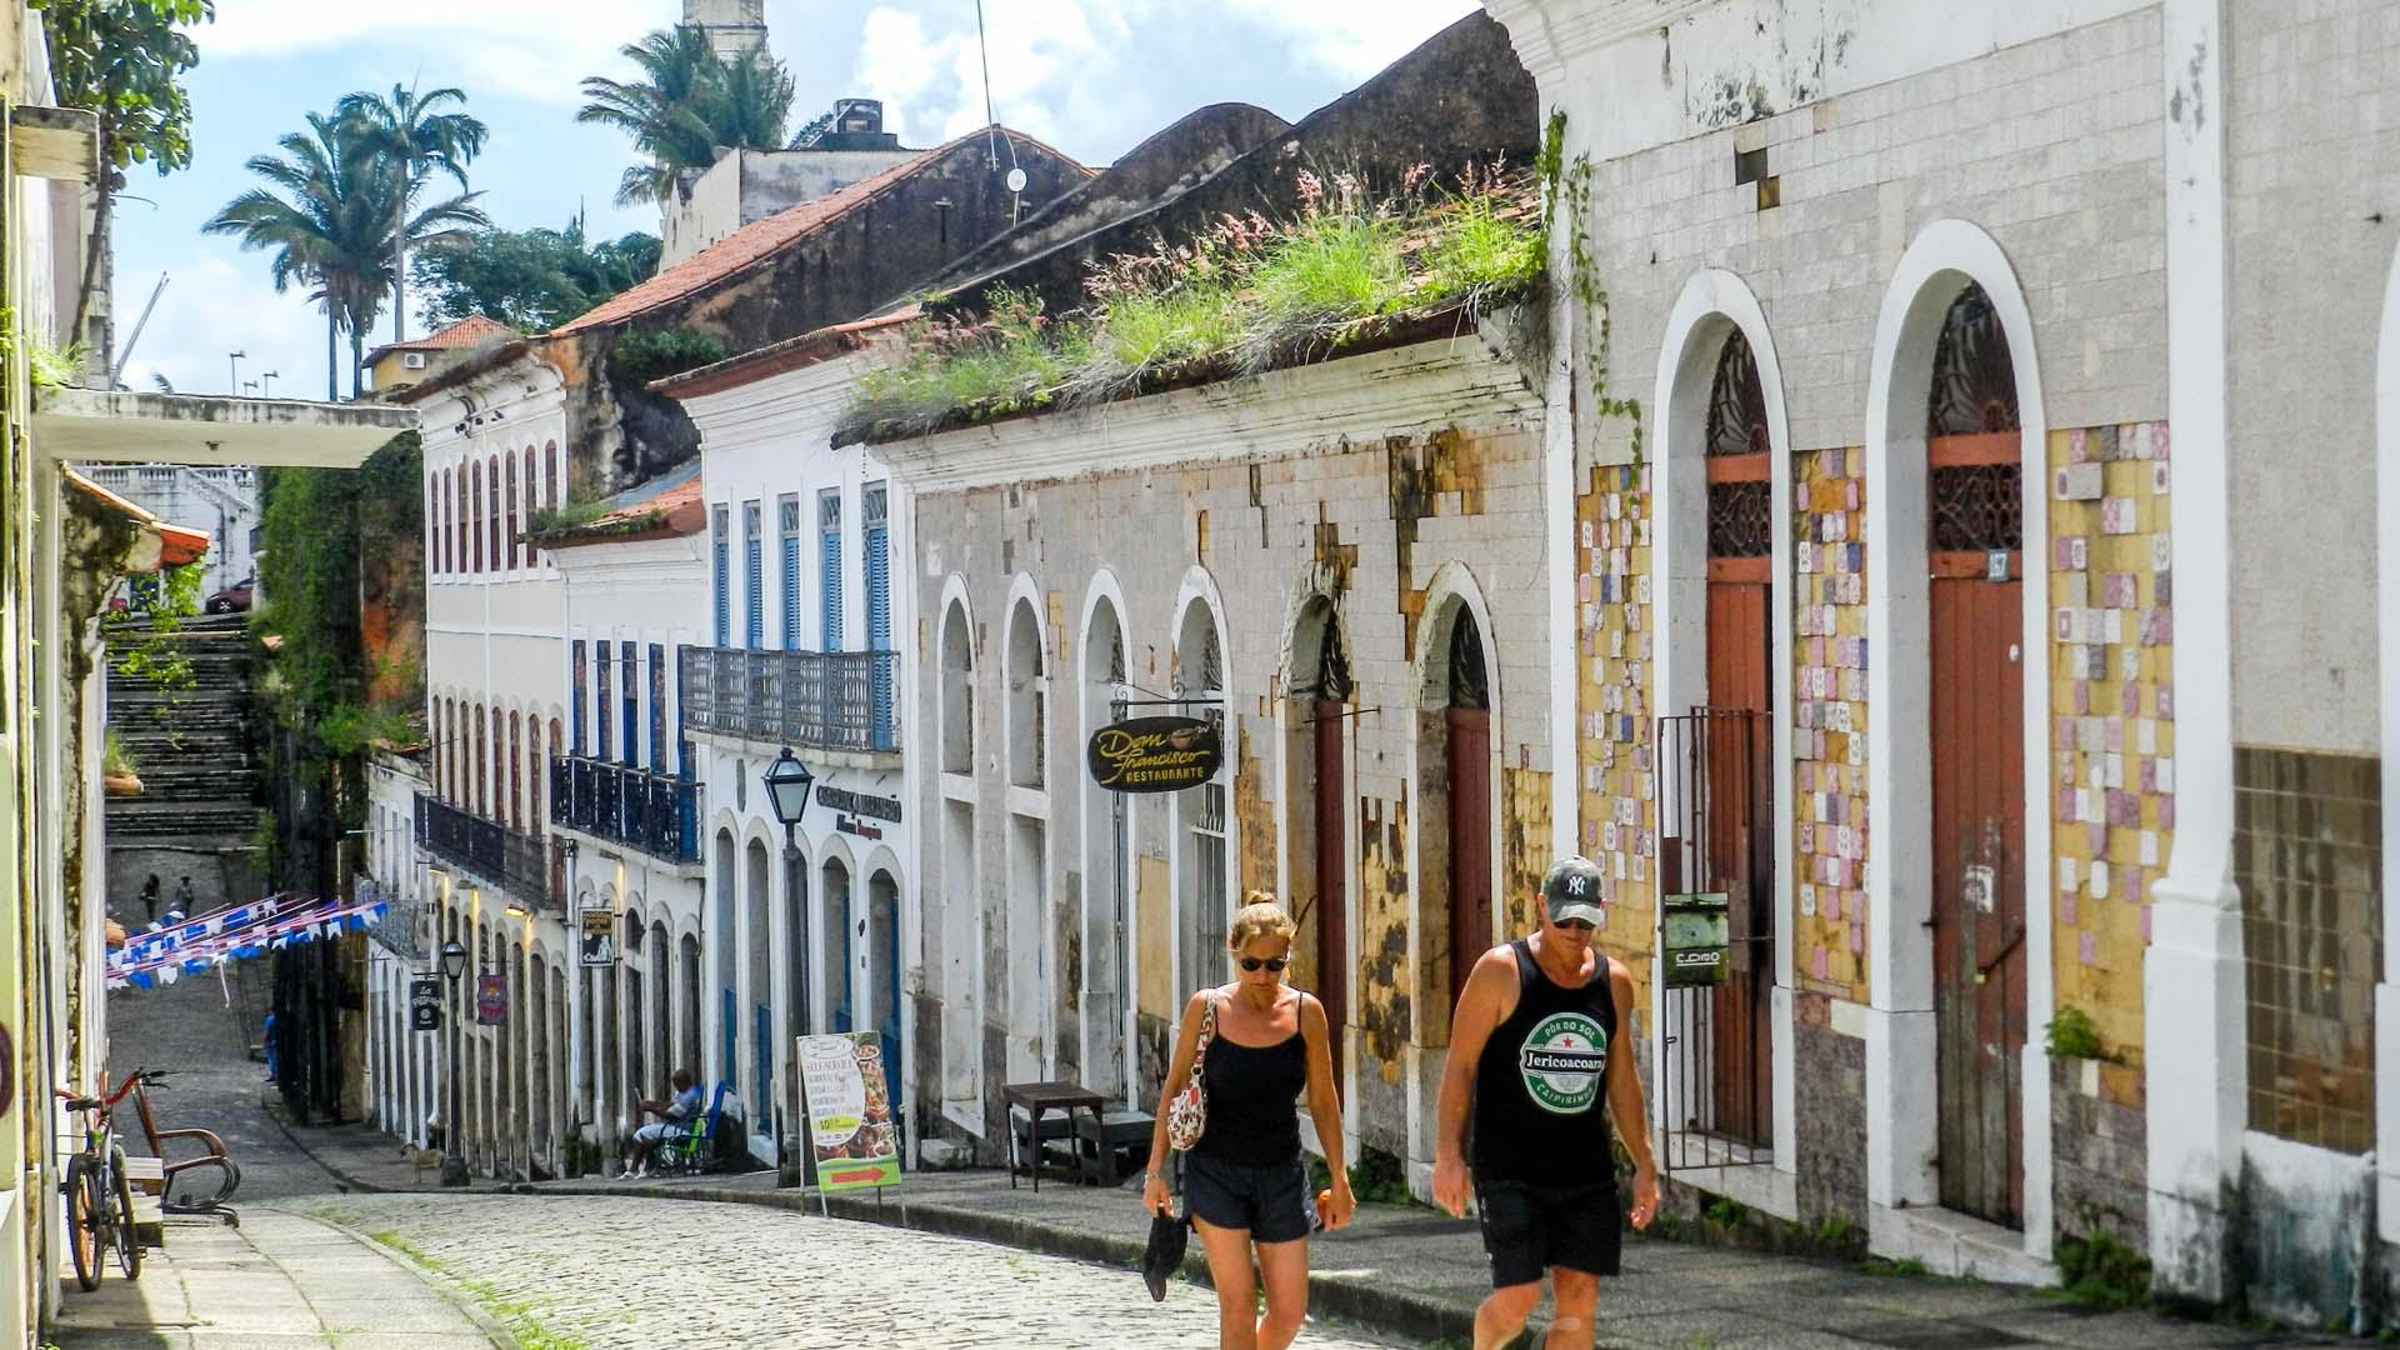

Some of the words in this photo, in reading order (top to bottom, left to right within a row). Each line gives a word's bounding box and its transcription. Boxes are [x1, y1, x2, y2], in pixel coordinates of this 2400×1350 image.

[1100, 748, 1211, 785] Francisco
[1126, 766, 1204, 784] RESTAURANTE
[1568, 876, 1585, 895] NY
[1563, 1021, 1577, 1030] DO
[1578, 1024, 1595, 1040] SOL
